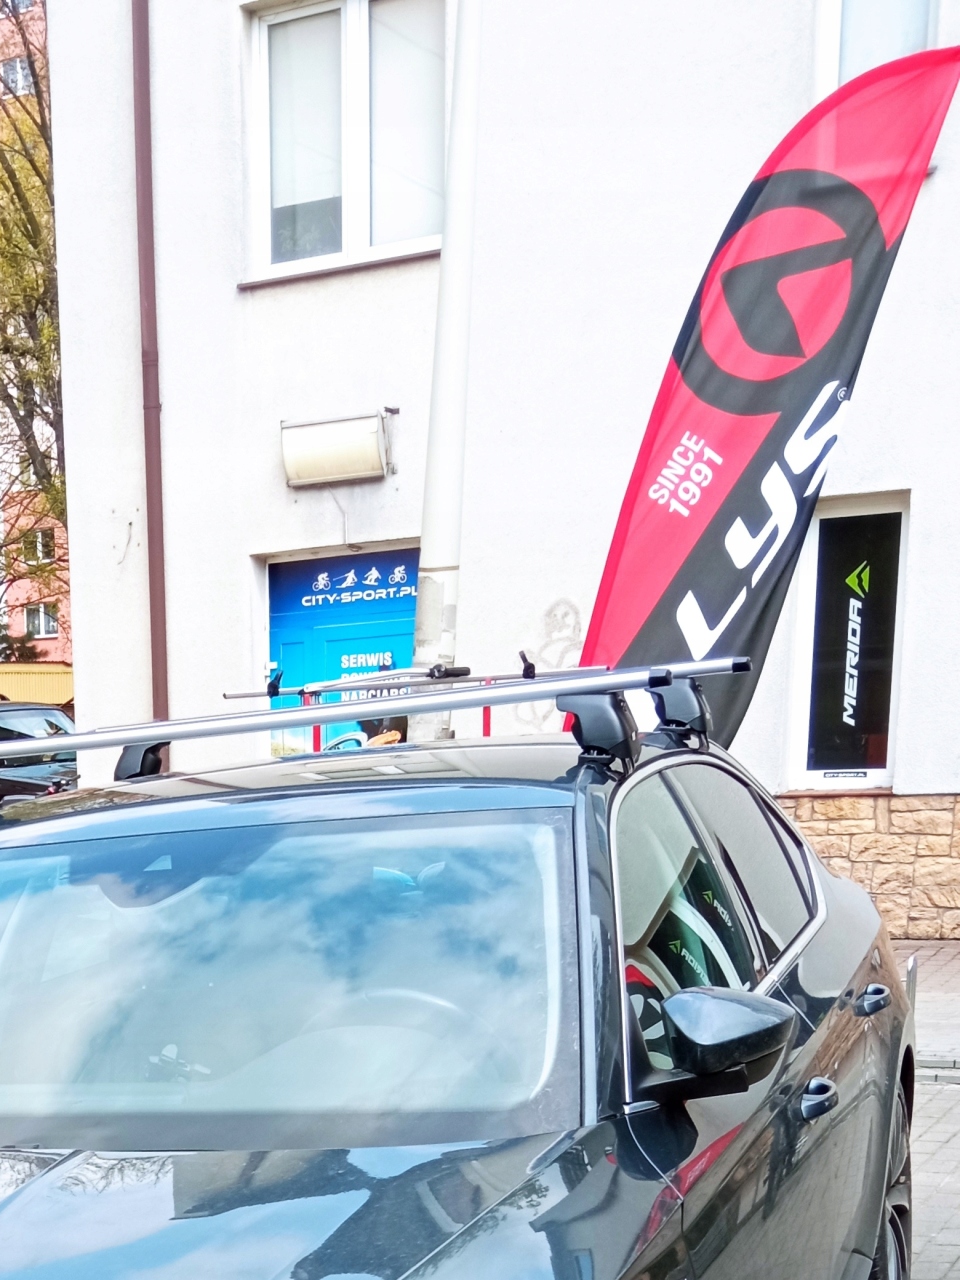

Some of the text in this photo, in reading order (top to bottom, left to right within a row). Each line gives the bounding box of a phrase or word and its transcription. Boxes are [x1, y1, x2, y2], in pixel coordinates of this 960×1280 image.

[648, 431, 705, 505] SINCE
[669, 446, 723, 517] 1991
[301, 586, 418, 607] CITY-SPORT.PL
[341, 652, 393, 669] SERWIS
[842, 597, 863, 727] MERIDA
